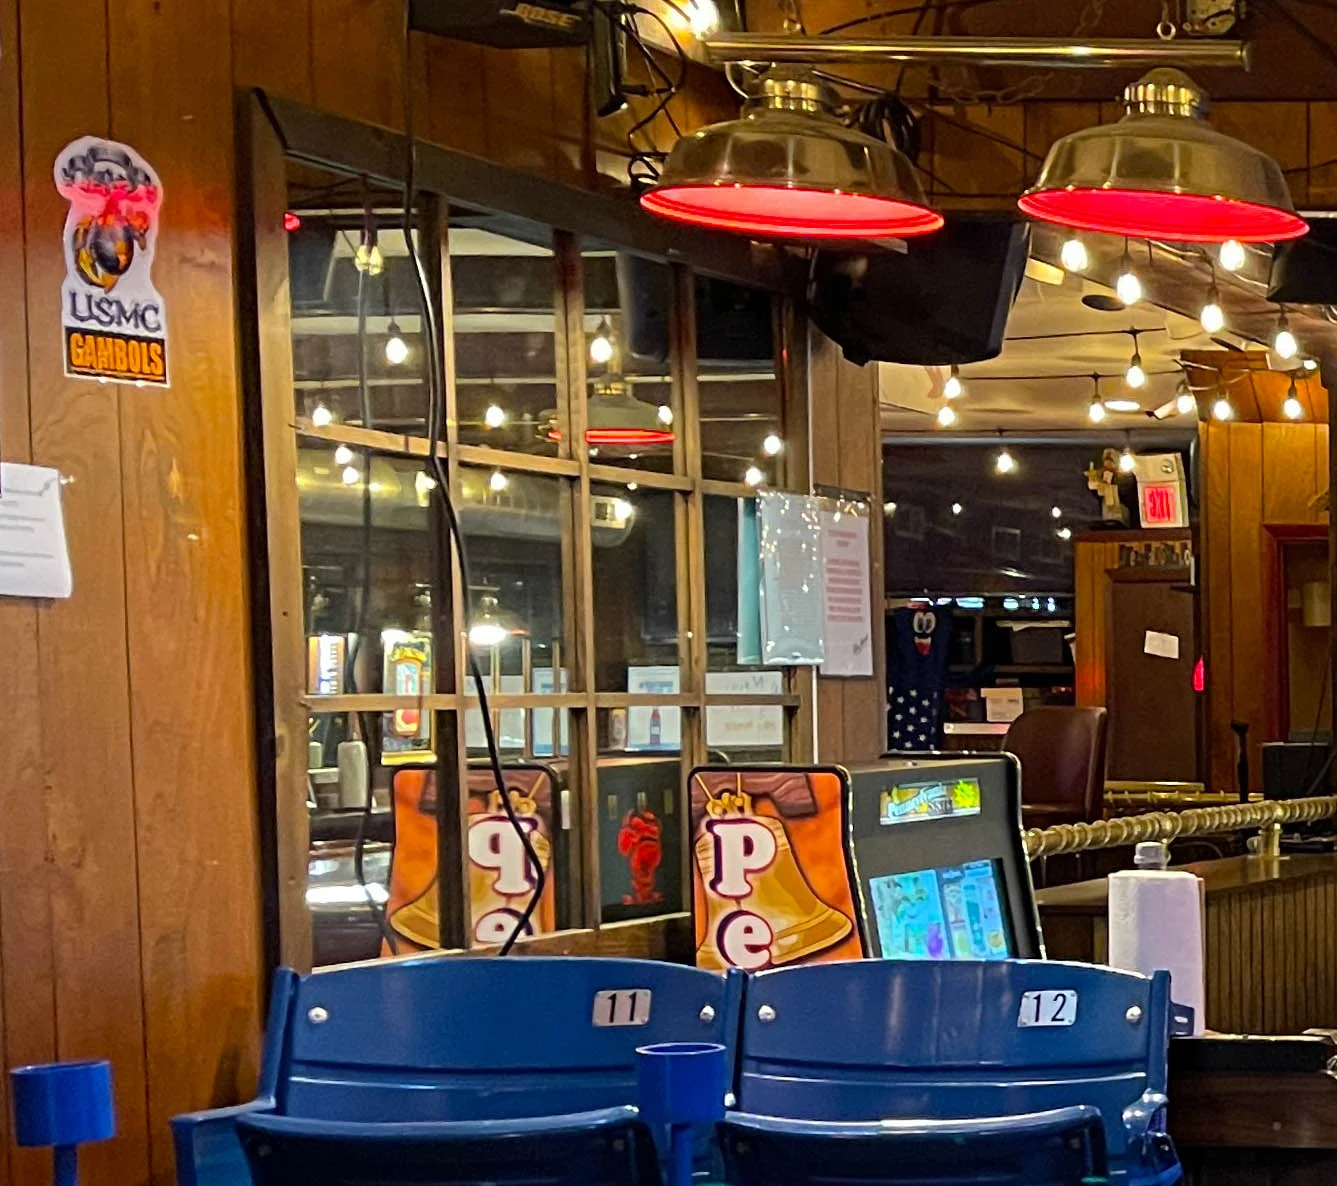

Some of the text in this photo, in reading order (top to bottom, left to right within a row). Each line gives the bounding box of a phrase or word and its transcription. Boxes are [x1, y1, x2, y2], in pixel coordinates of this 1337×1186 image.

[69, 292, 161, 333] USMC
[607, 993, 638, 1024] 11
[1032, 993, 1066, 1023] 12
